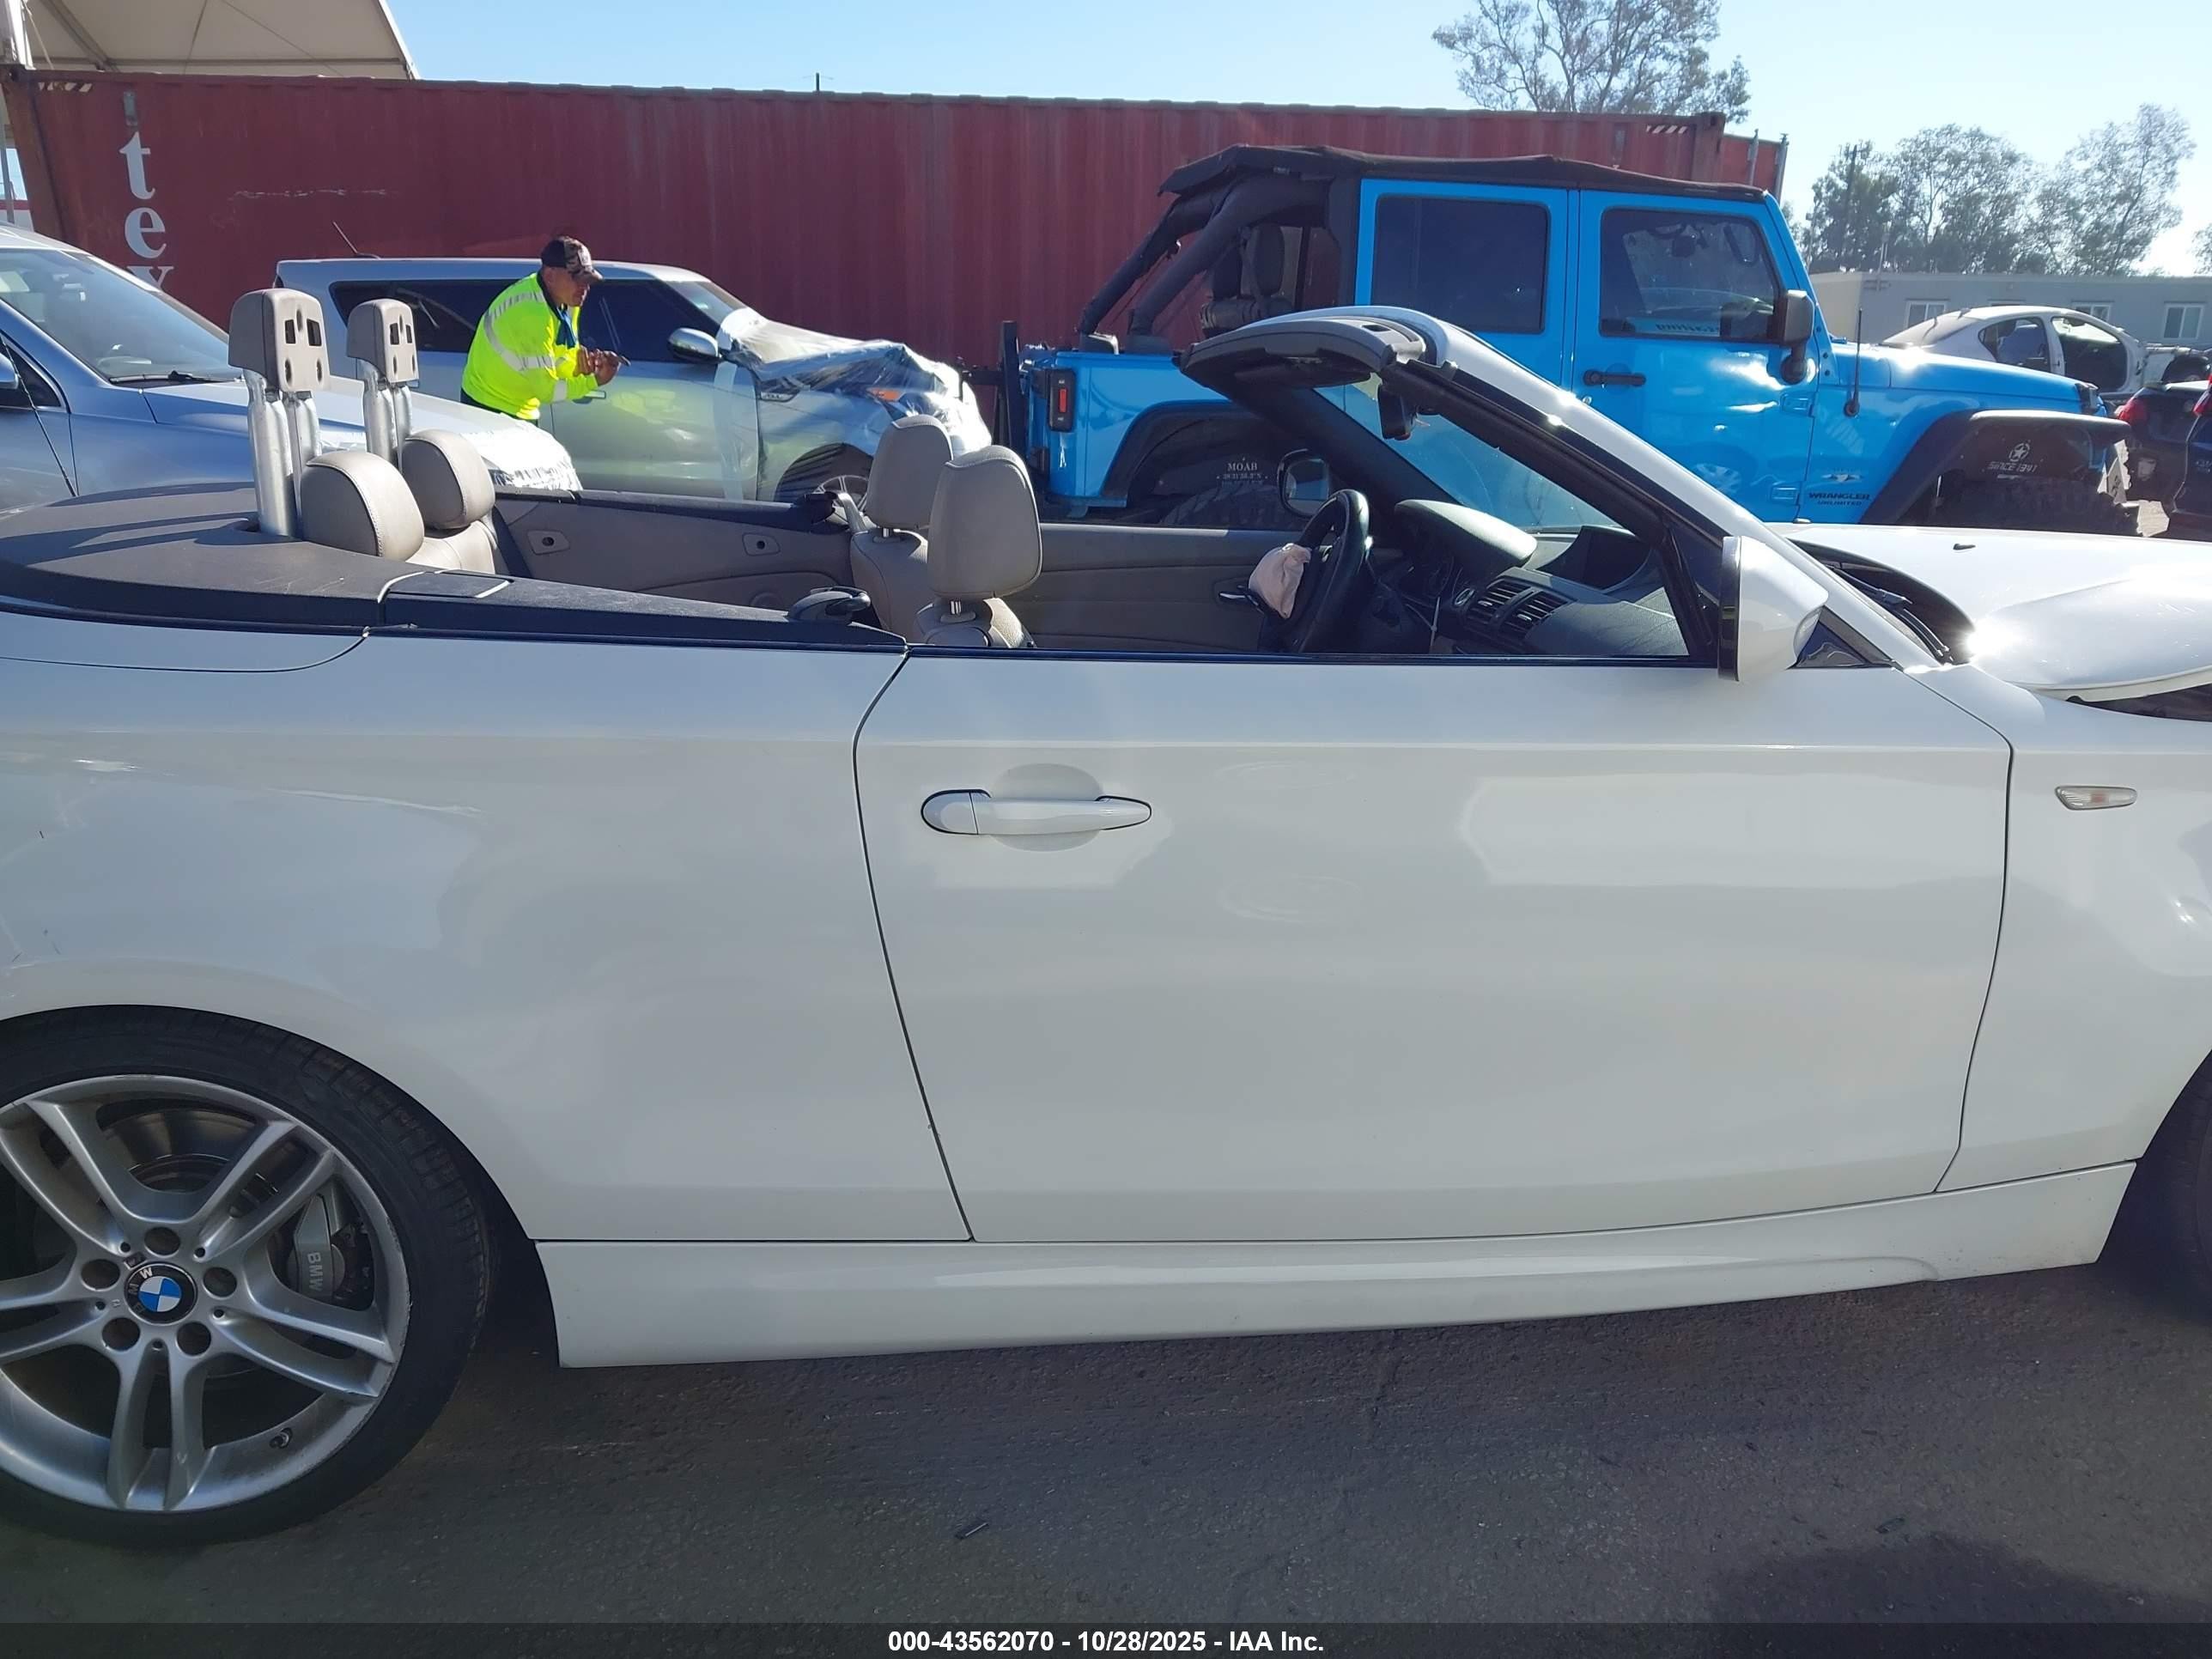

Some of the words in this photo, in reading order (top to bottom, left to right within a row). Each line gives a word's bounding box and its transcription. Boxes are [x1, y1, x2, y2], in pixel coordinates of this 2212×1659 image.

[1227, 462, 1258, 471] MOAB
[1808, 492, 1870, 501] WRANGLER
[307, 1252, 324, 1291] BMW
